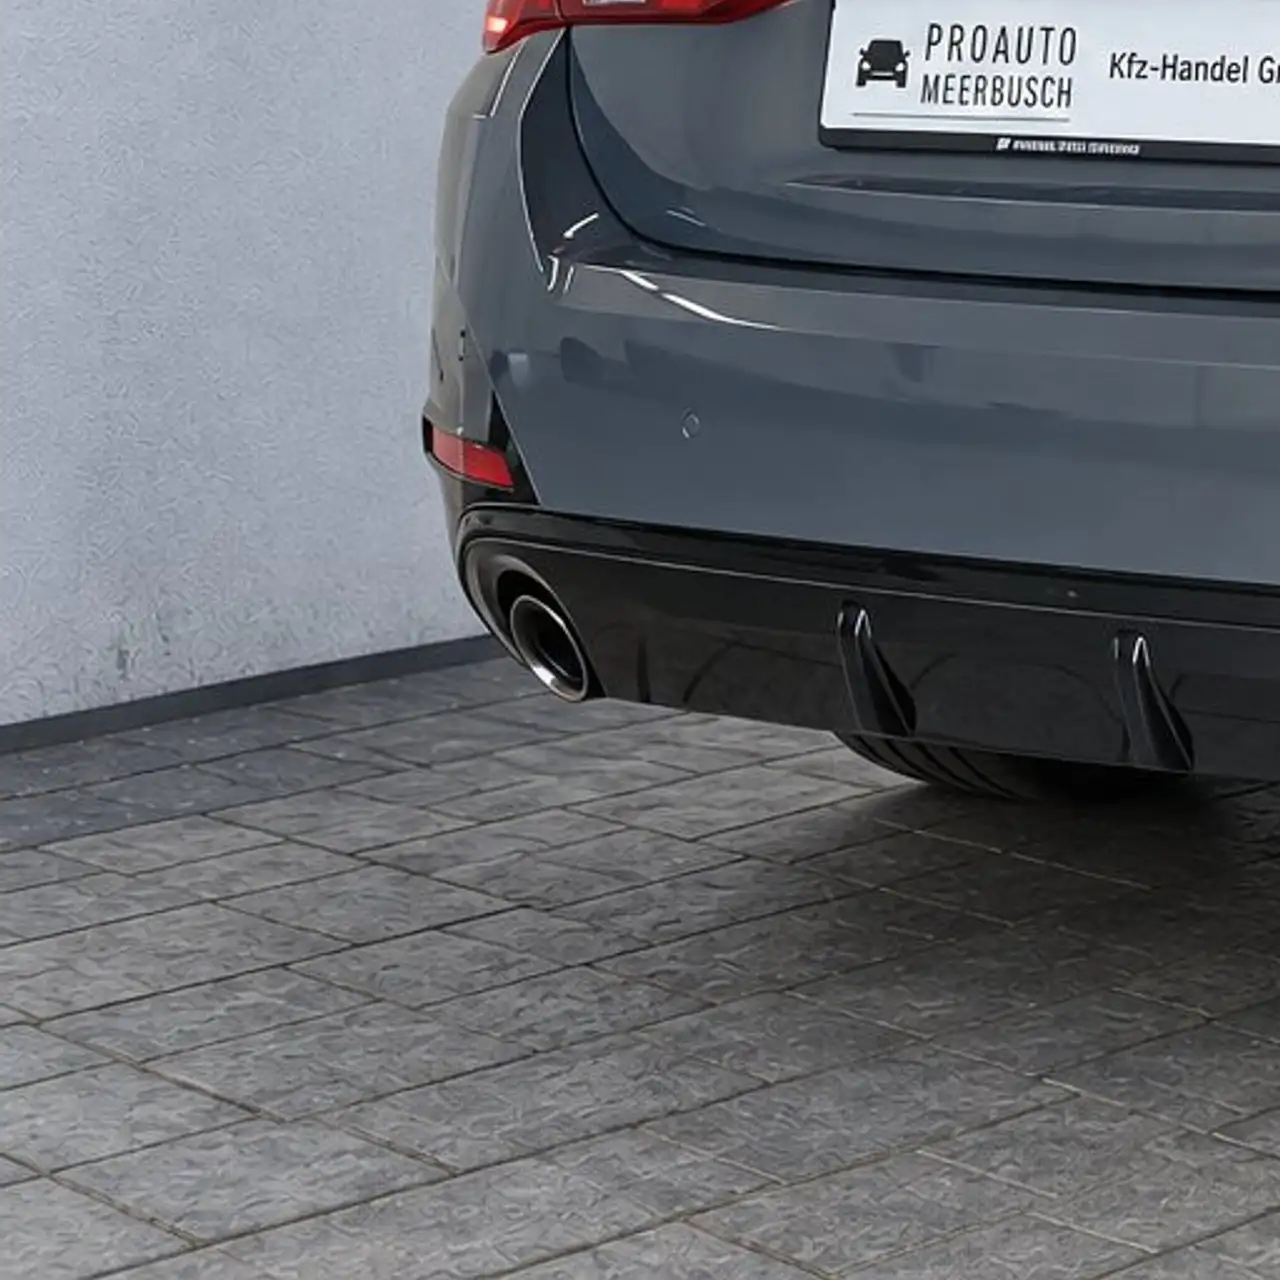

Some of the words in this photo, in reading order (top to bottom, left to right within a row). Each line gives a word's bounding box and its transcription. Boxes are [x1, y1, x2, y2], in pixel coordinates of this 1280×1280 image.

[924, 22, 1078, 66] PROAUTO
[1109, 51, 1249, 84] Kfz-Handel
[919, 73, 1073, 109] MEERBUSCH
